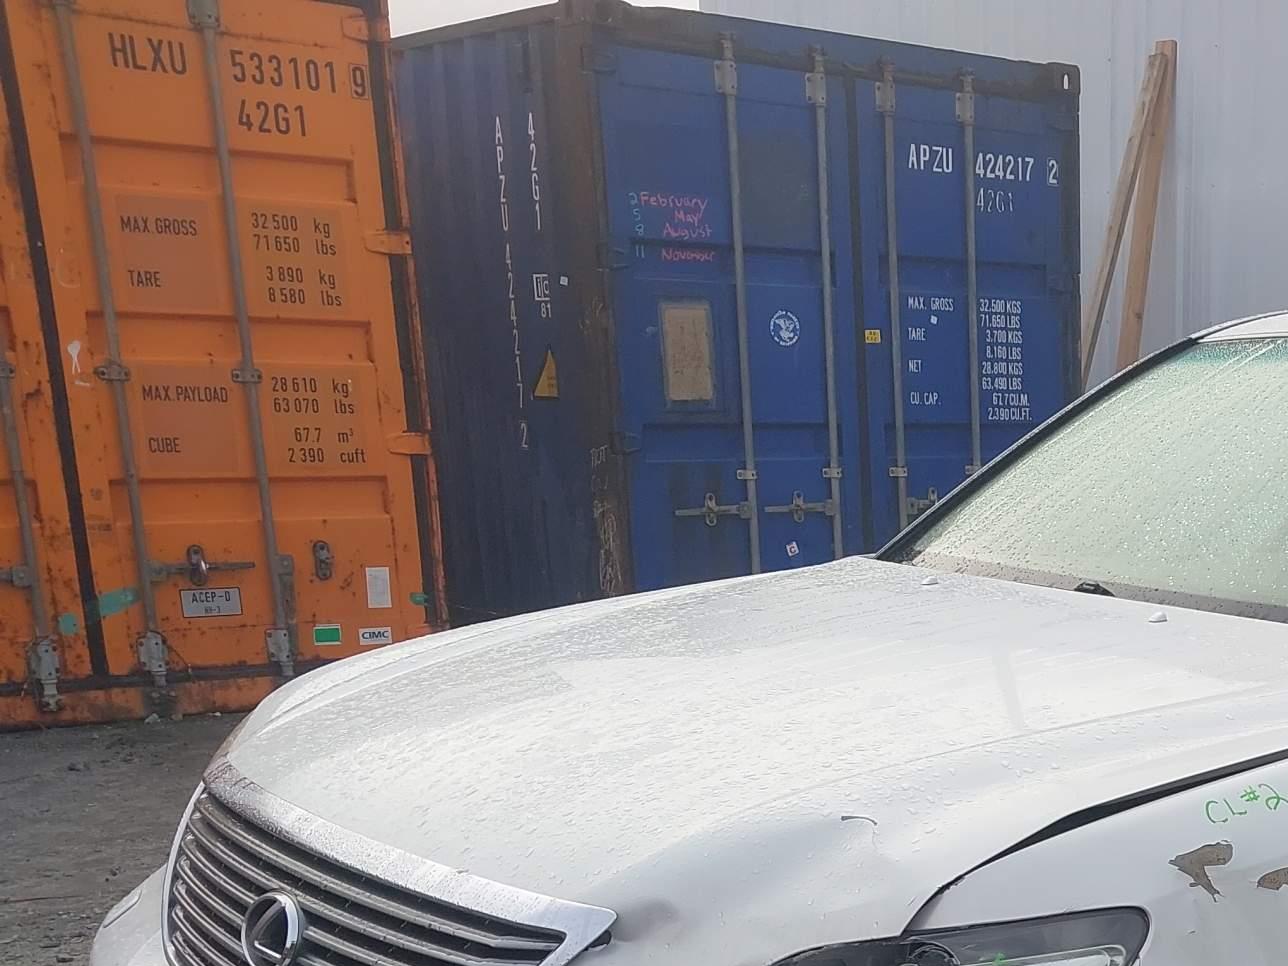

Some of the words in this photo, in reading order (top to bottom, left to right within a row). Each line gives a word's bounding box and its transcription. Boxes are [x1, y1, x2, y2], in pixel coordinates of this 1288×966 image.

[108, 32, 188, 76] HLXU
[229, 48, 338, 94] 533101
[351, 65, 367, 98] 9
[238, 99, 308, 137] 42G1
[908, 143, 953, 173] APZU
[975, 152, 1034, 182] 424217
[1048, 158, 1059, 185] 2
[640, 191, 708, 218] February
[313, 218, 331, 239] kg
[663, 222, 713, 241] August
[315, 239, 337, 257] lbs
[127, 269, 162, 288] TARE
[318, 268, 336, 290] kg
[321, 290, 343, 307] lbs
[930, 297, 954, 312] GROSS
[1006, 301, 1022, 314] KGS
[1007, 316, 1021, 329] LBS
[908, 328, 926, 341] TARE
[1008, 331, 1023, 344] KGS
[1008, 347, 1022, 360] LBS
[908, 359, 922, 373] NET
[1008, 362, 1023, 375] KGS
[332, 378, 350, 398] kg
[1008, 377, 1022, 390] LBS
[334, 398, 355, 415] lbs
[294, 427, 322, 444] 67.7
[148, 436, 182, 454] CUBE
[340, 448, 367, 464] cuft
[361, 630, 390, 640] CIMC
